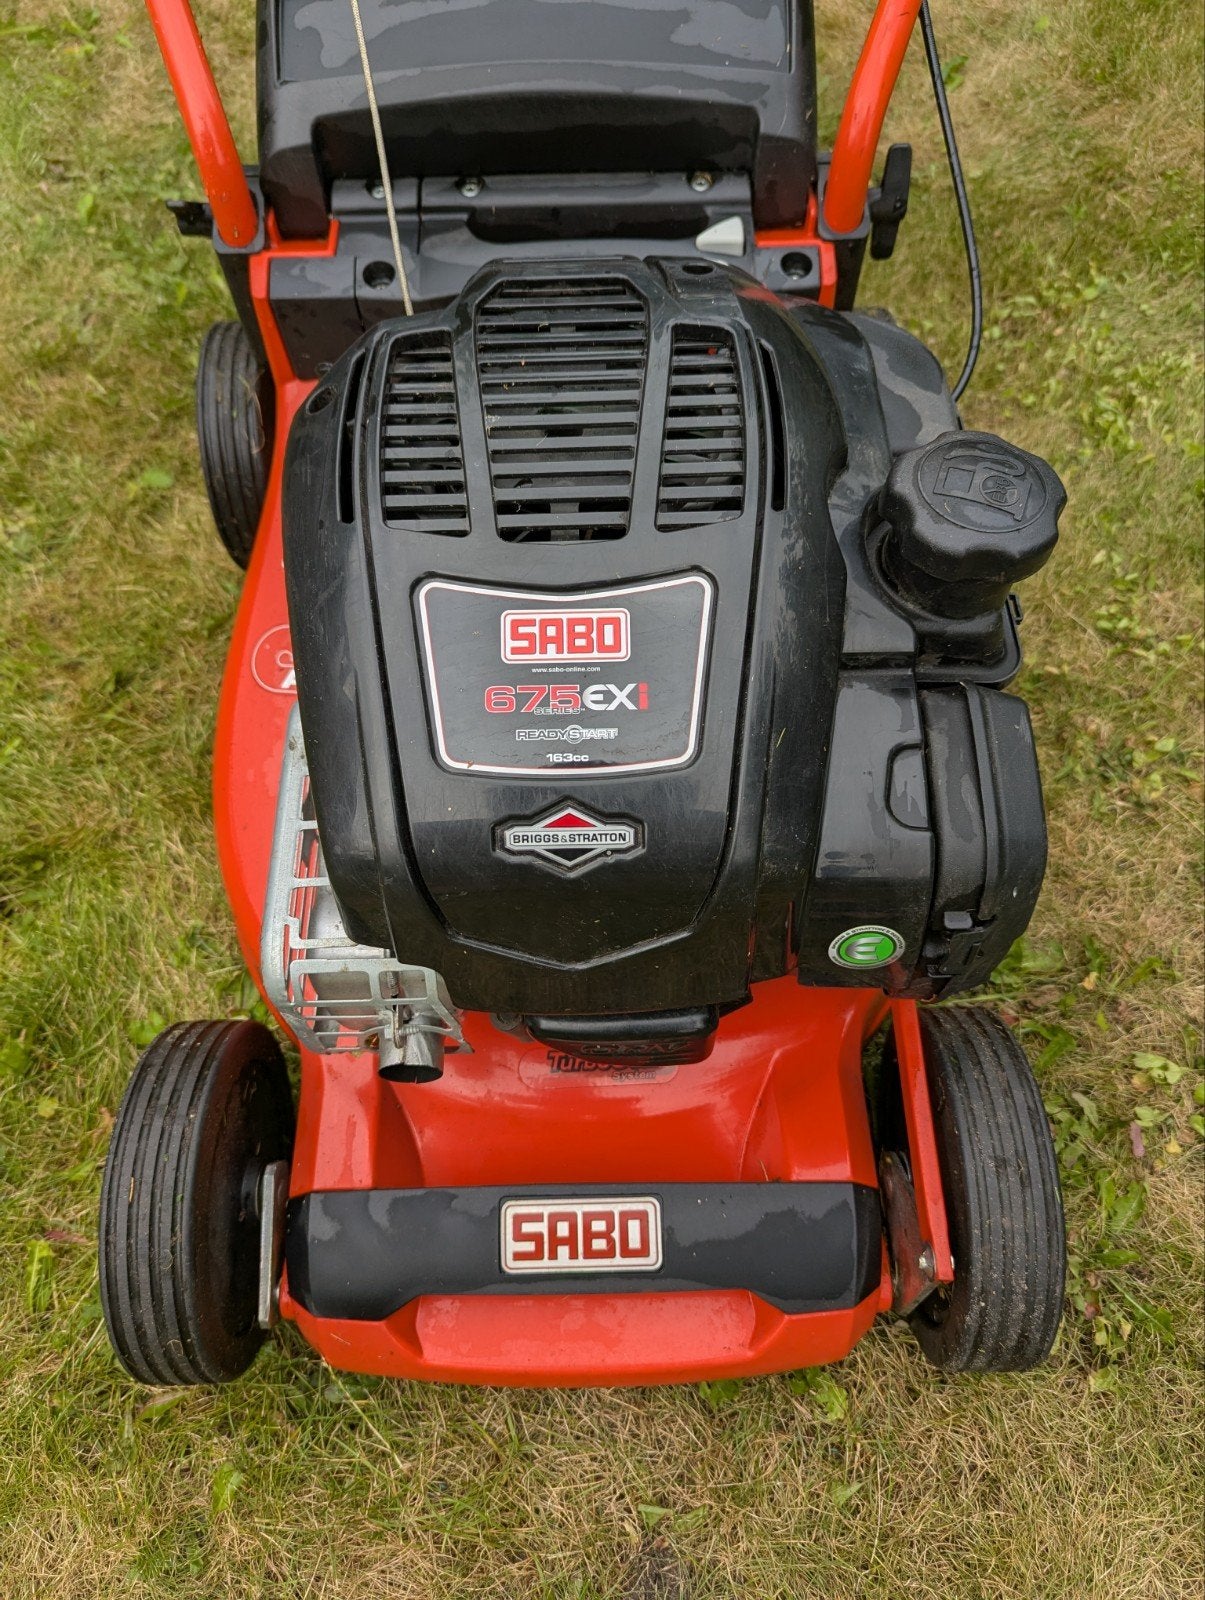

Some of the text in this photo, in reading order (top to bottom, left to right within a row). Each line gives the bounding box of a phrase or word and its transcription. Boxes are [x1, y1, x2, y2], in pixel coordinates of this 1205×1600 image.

[510, 617, 621, 655] SABO
[546, 753, 589, 762] 163cc
[512, 1209, 650, 1262] SABO
